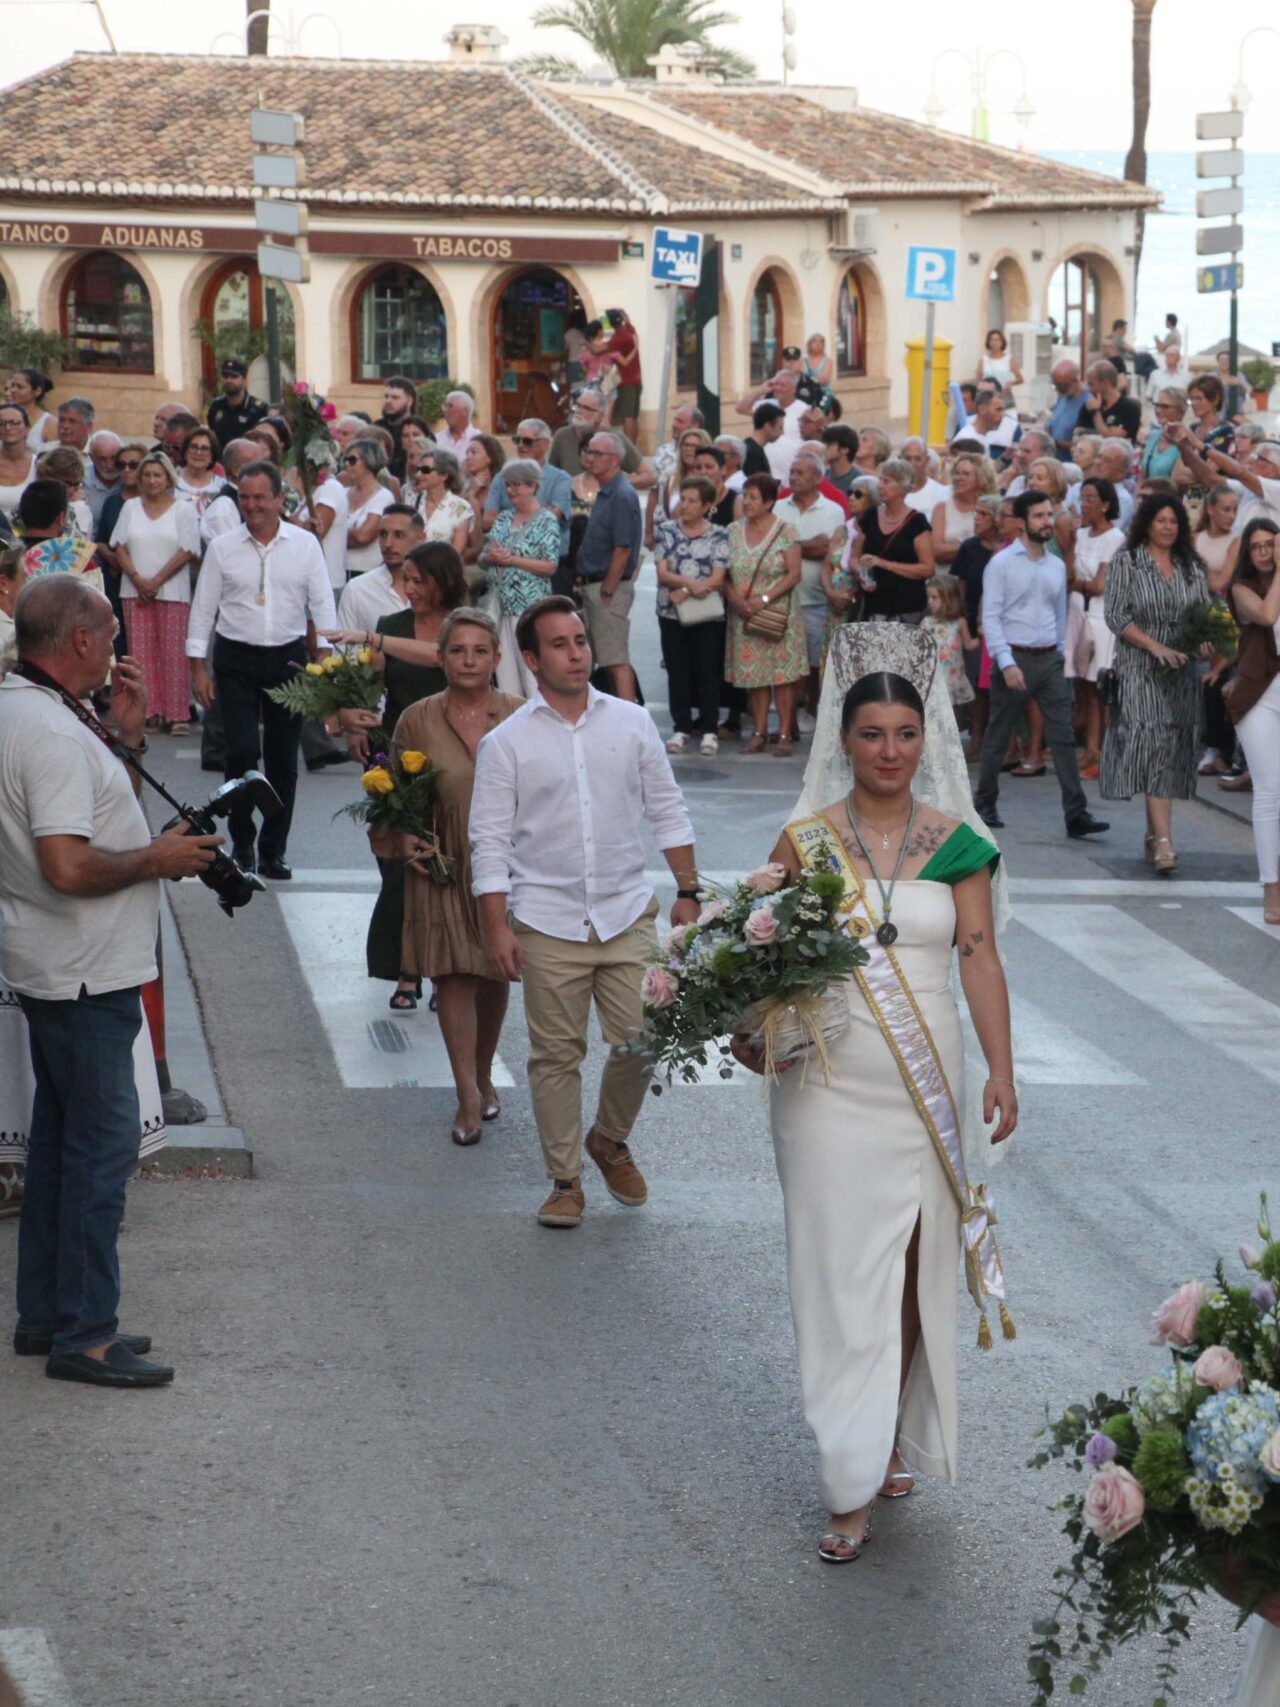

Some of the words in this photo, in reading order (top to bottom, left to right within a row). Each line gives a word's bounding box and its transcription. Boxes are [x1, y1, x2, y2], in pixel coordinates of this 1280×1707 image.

[100, 226, 204, 248] ADUANAS
[413, 237, 512, 258] TABACOS
[656, 247, 696, 265] TAXI
[914, 251, 946, 294] P
[797, 827, 829, 843] 2023
